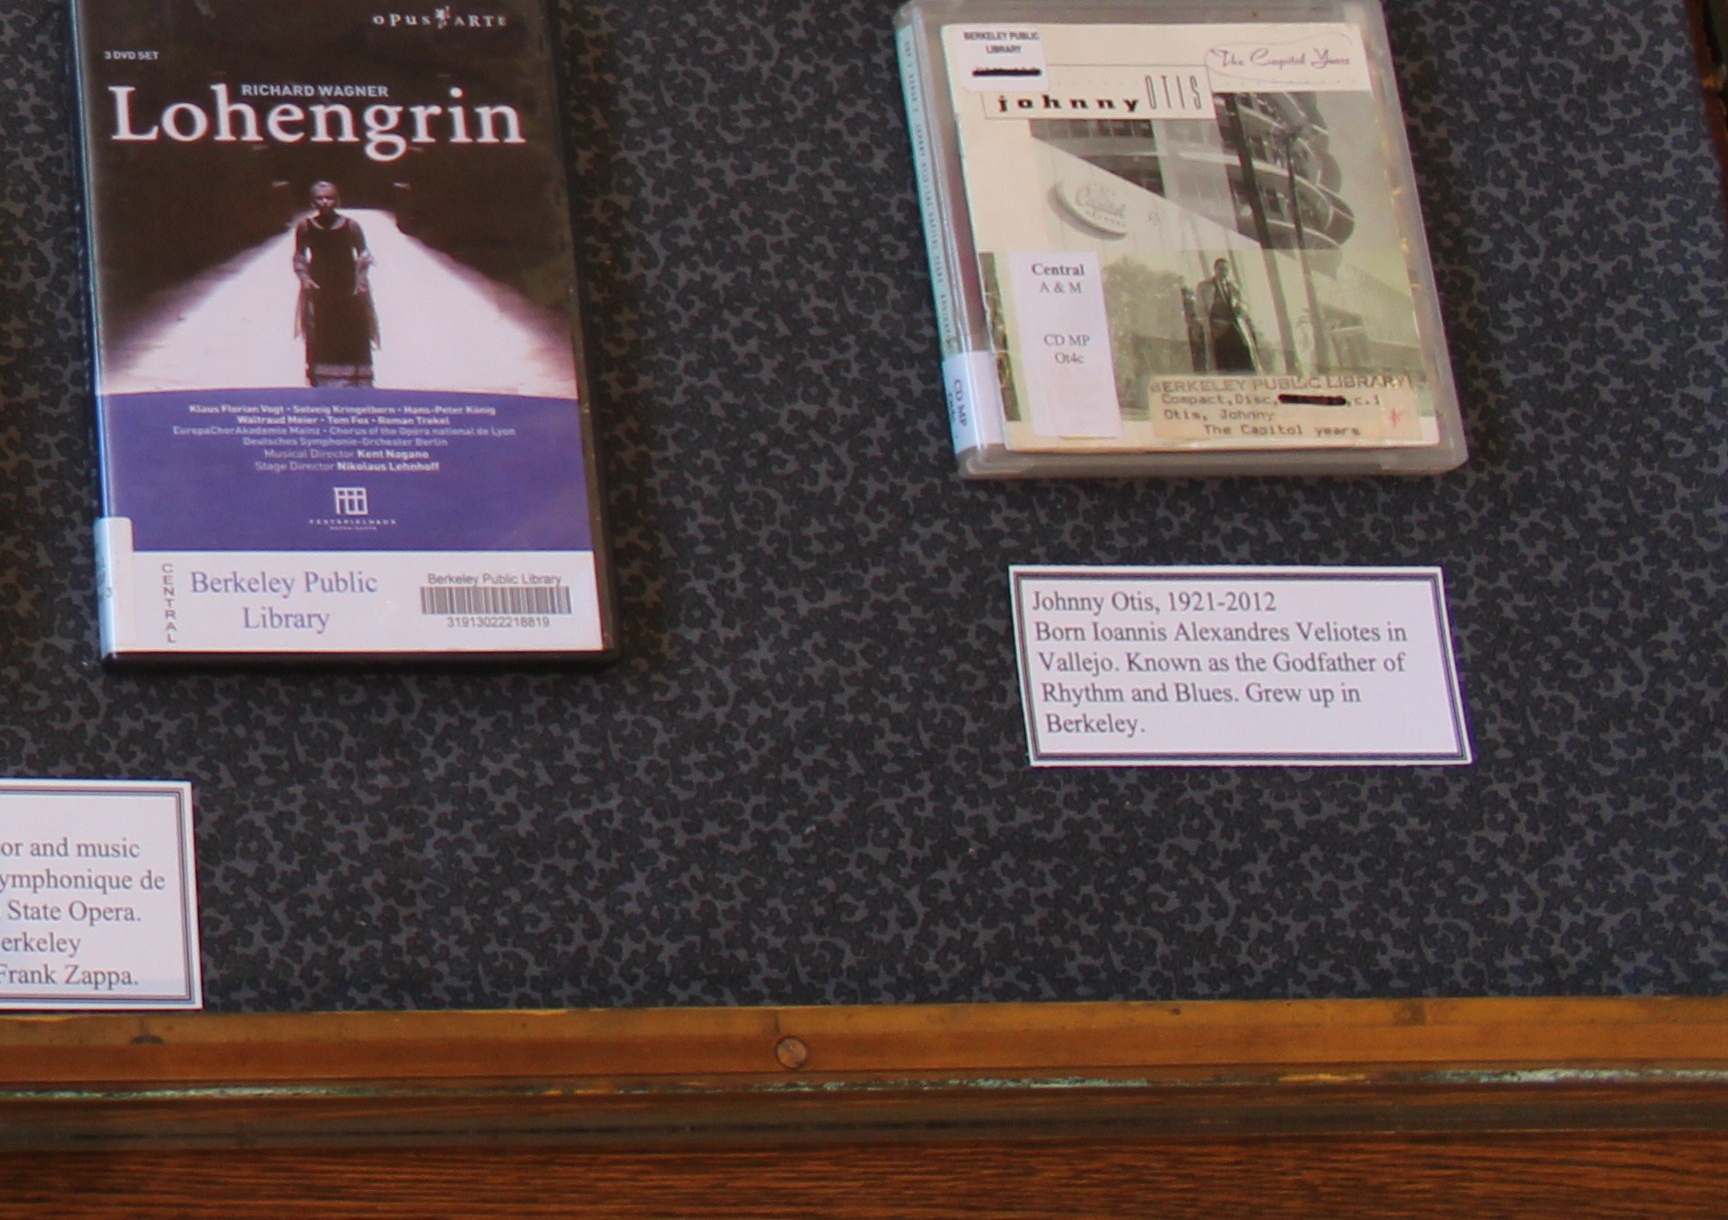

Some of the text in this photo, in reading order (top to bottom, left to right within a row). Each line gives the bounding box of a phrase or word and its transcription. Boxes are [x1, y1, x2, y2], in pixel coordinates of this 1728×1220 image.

[242, 85, 389, 97] RICHARD WAGNER
[998, 75, 1203, 112] johnny OTIS
[107, 84, 525, 162] Lohengrin
[1205, 425, 1230, 435] The
[1241, 425, 1302, 435] Capitol
[191, 571, 378, 596] Berkeley Public
[1032, 590, 1277, 617] Johnny Otis, 1921-2012
[242, 607, 330, 634] Library
